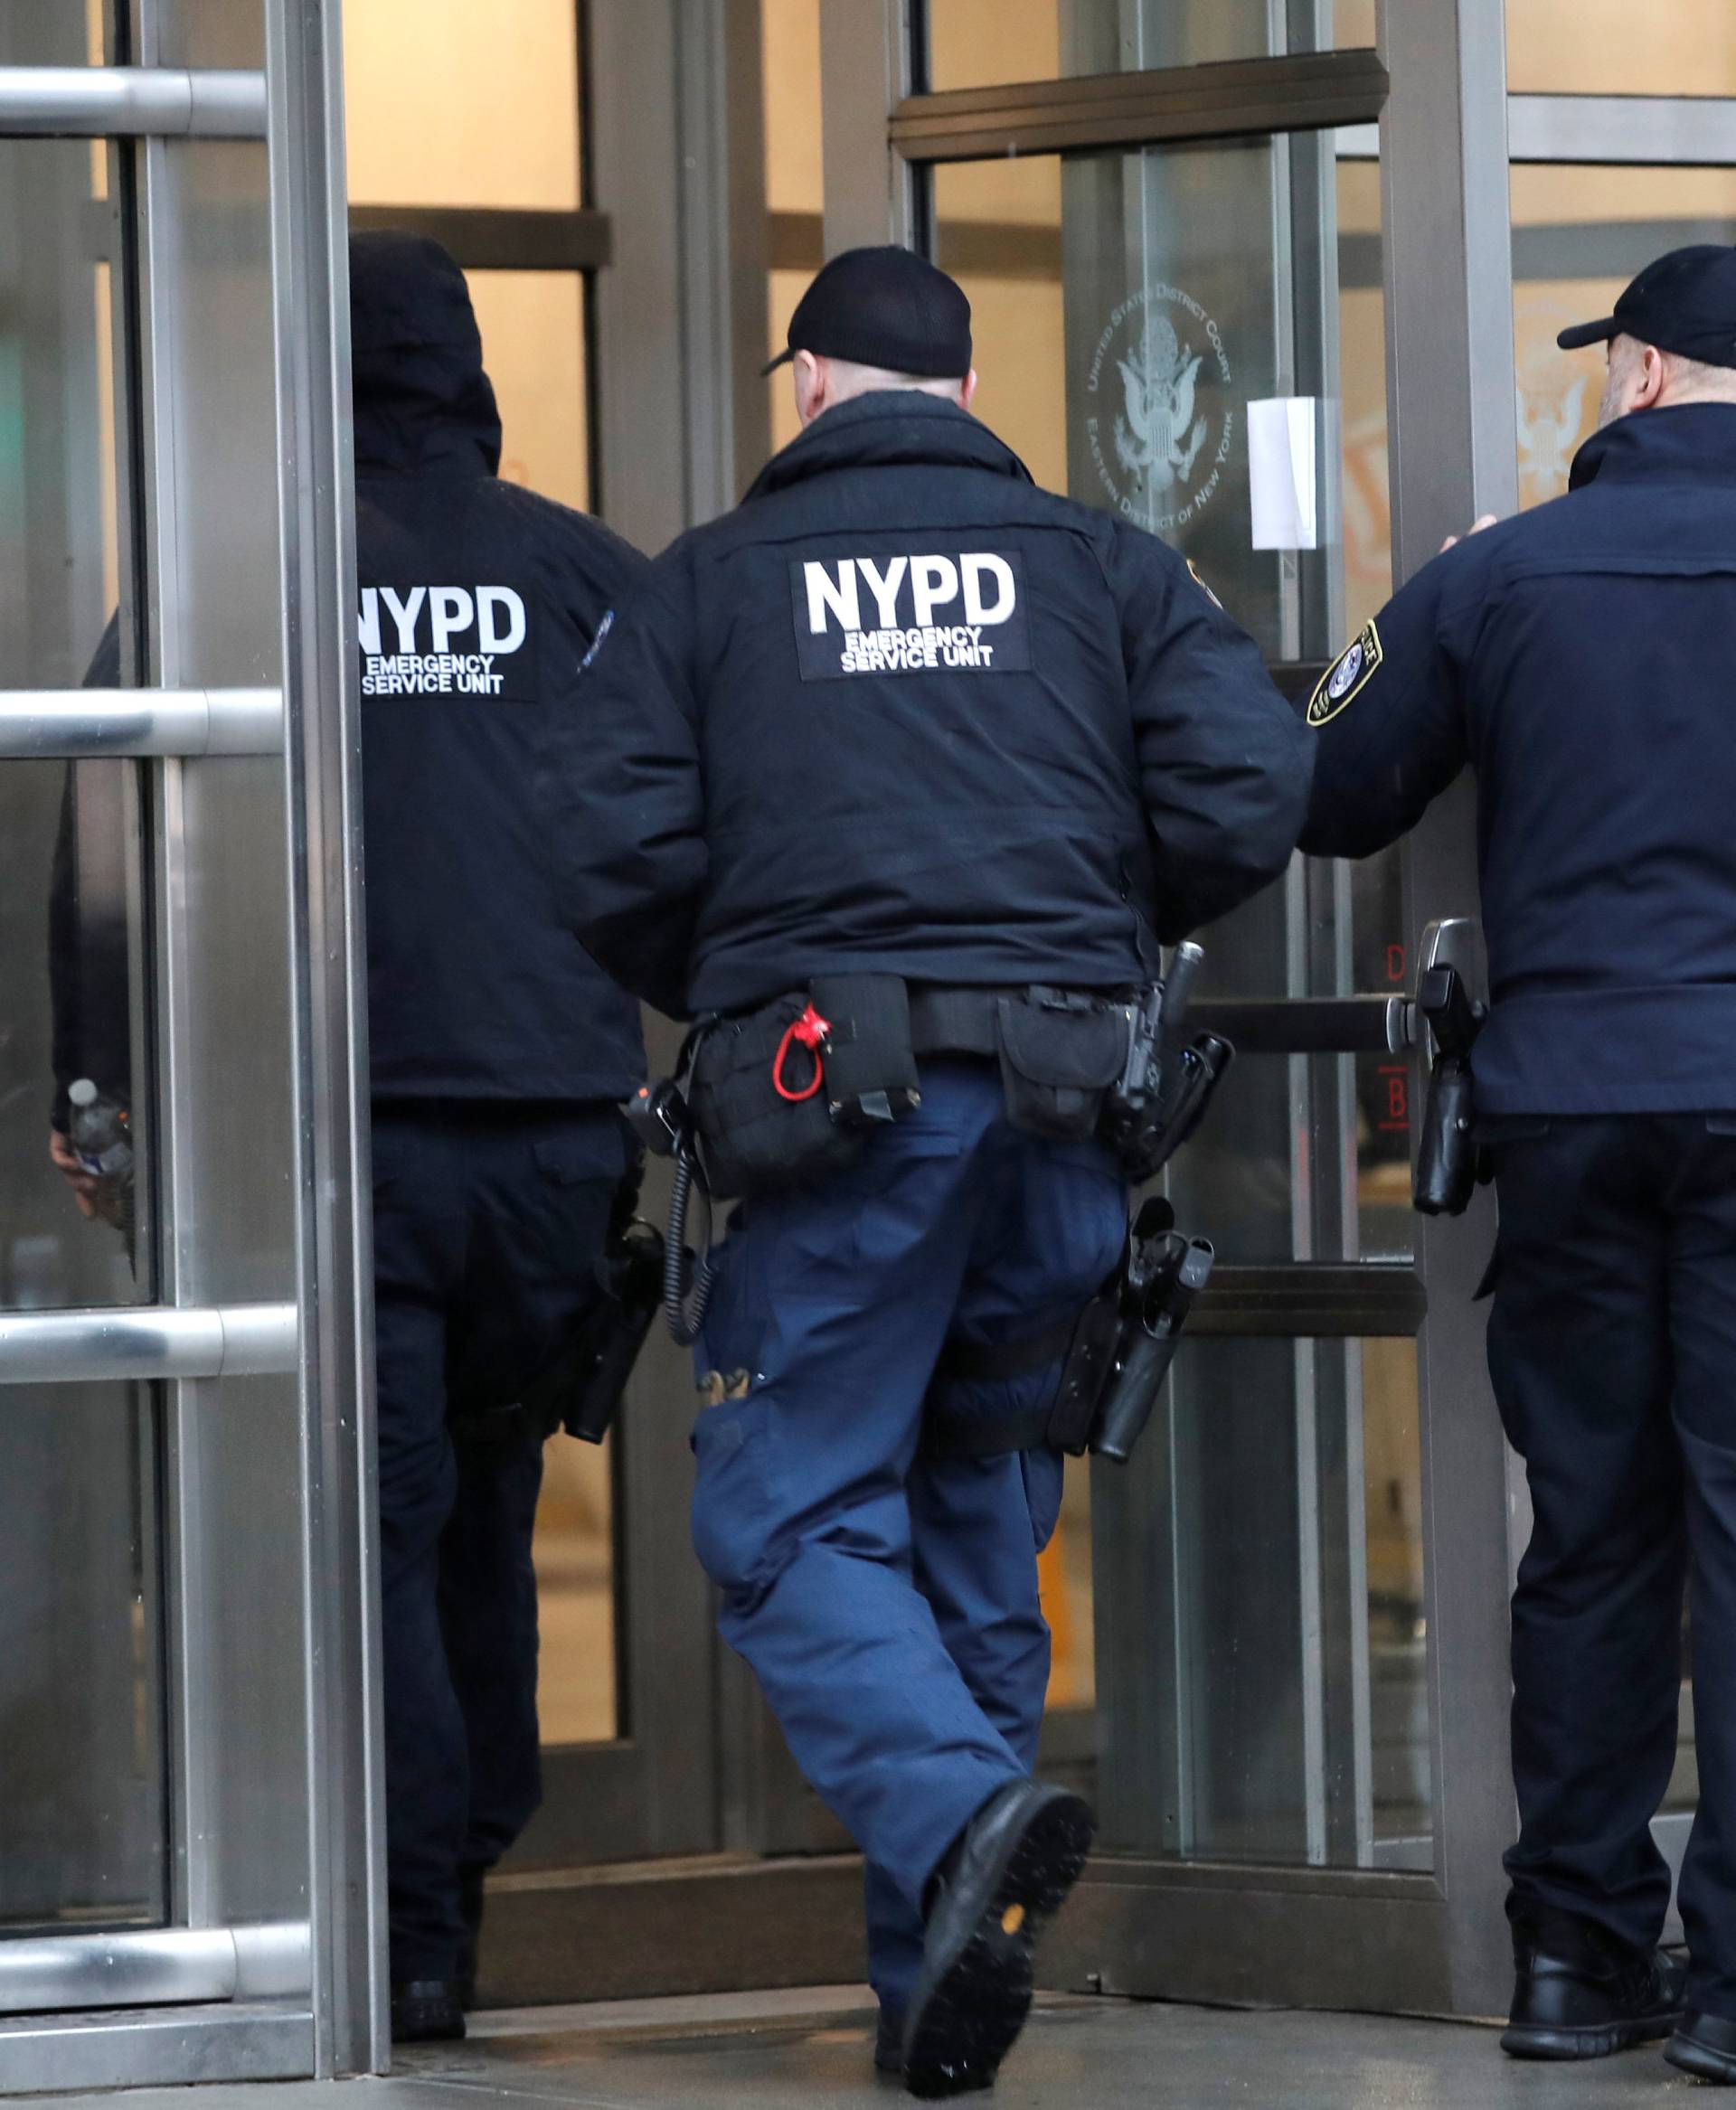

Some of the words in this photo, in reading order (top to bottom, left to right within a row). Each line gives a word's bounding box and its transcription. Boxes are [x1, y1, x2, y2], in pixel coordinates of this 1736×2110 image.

[1087, 325, 1114, 392] UNITED
[1156, 282, 1208, 322] DISTRICT
[1206, 319, 1231, 383] COURT
[1178, 504, 1193, 524] OF
[1194, 468, 1220, 509] NEW
[1215, 411, 1233, 463] YORK
[803, 552, 1016, 635] NYPD
[844, 626, 984, 654] EMERGENCY
[366, 654, 495, 676] EMERGENCY
[840, 647, 938, 674] SERVICE
[943, 645, 994, 667] UNIT
[362, 674, 453, 695] SERVICE
[457, 674, 505, 694] UNIT
